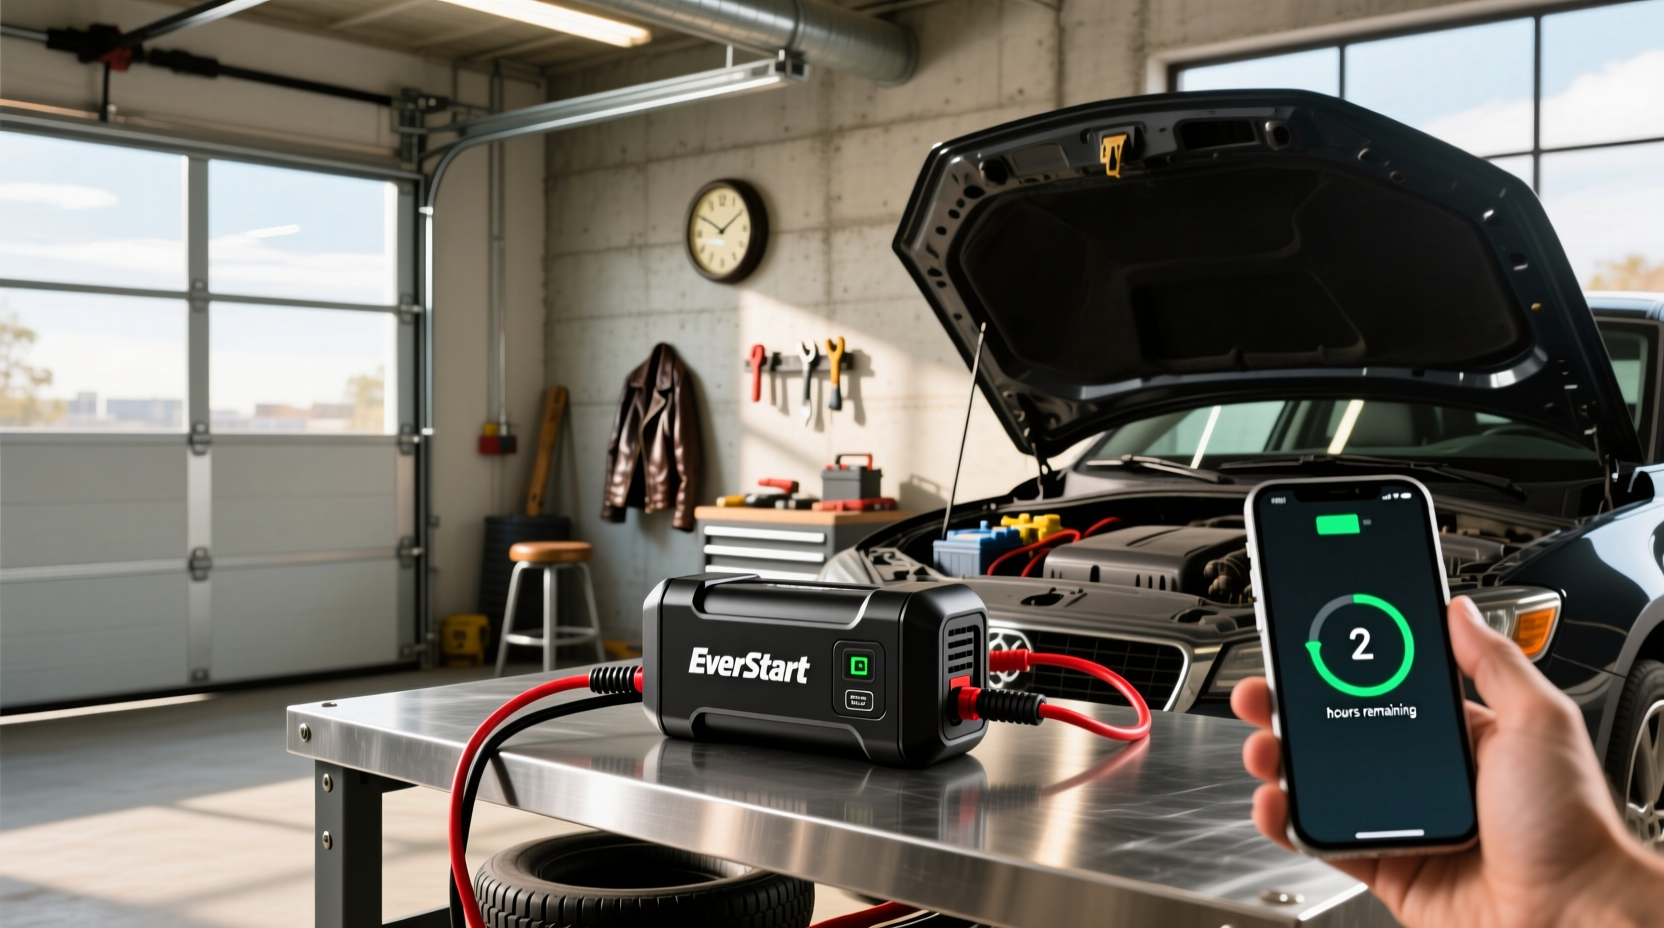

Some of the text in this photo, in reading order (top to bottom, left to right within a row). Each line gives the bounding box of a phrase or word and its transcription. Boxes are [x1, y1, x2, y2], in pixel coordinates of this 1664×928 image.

[1349, 627, 1374, 661] 2
[688, 646, 811, 685] EverStart
[1326, 703, 1417, 719] hours remaining
